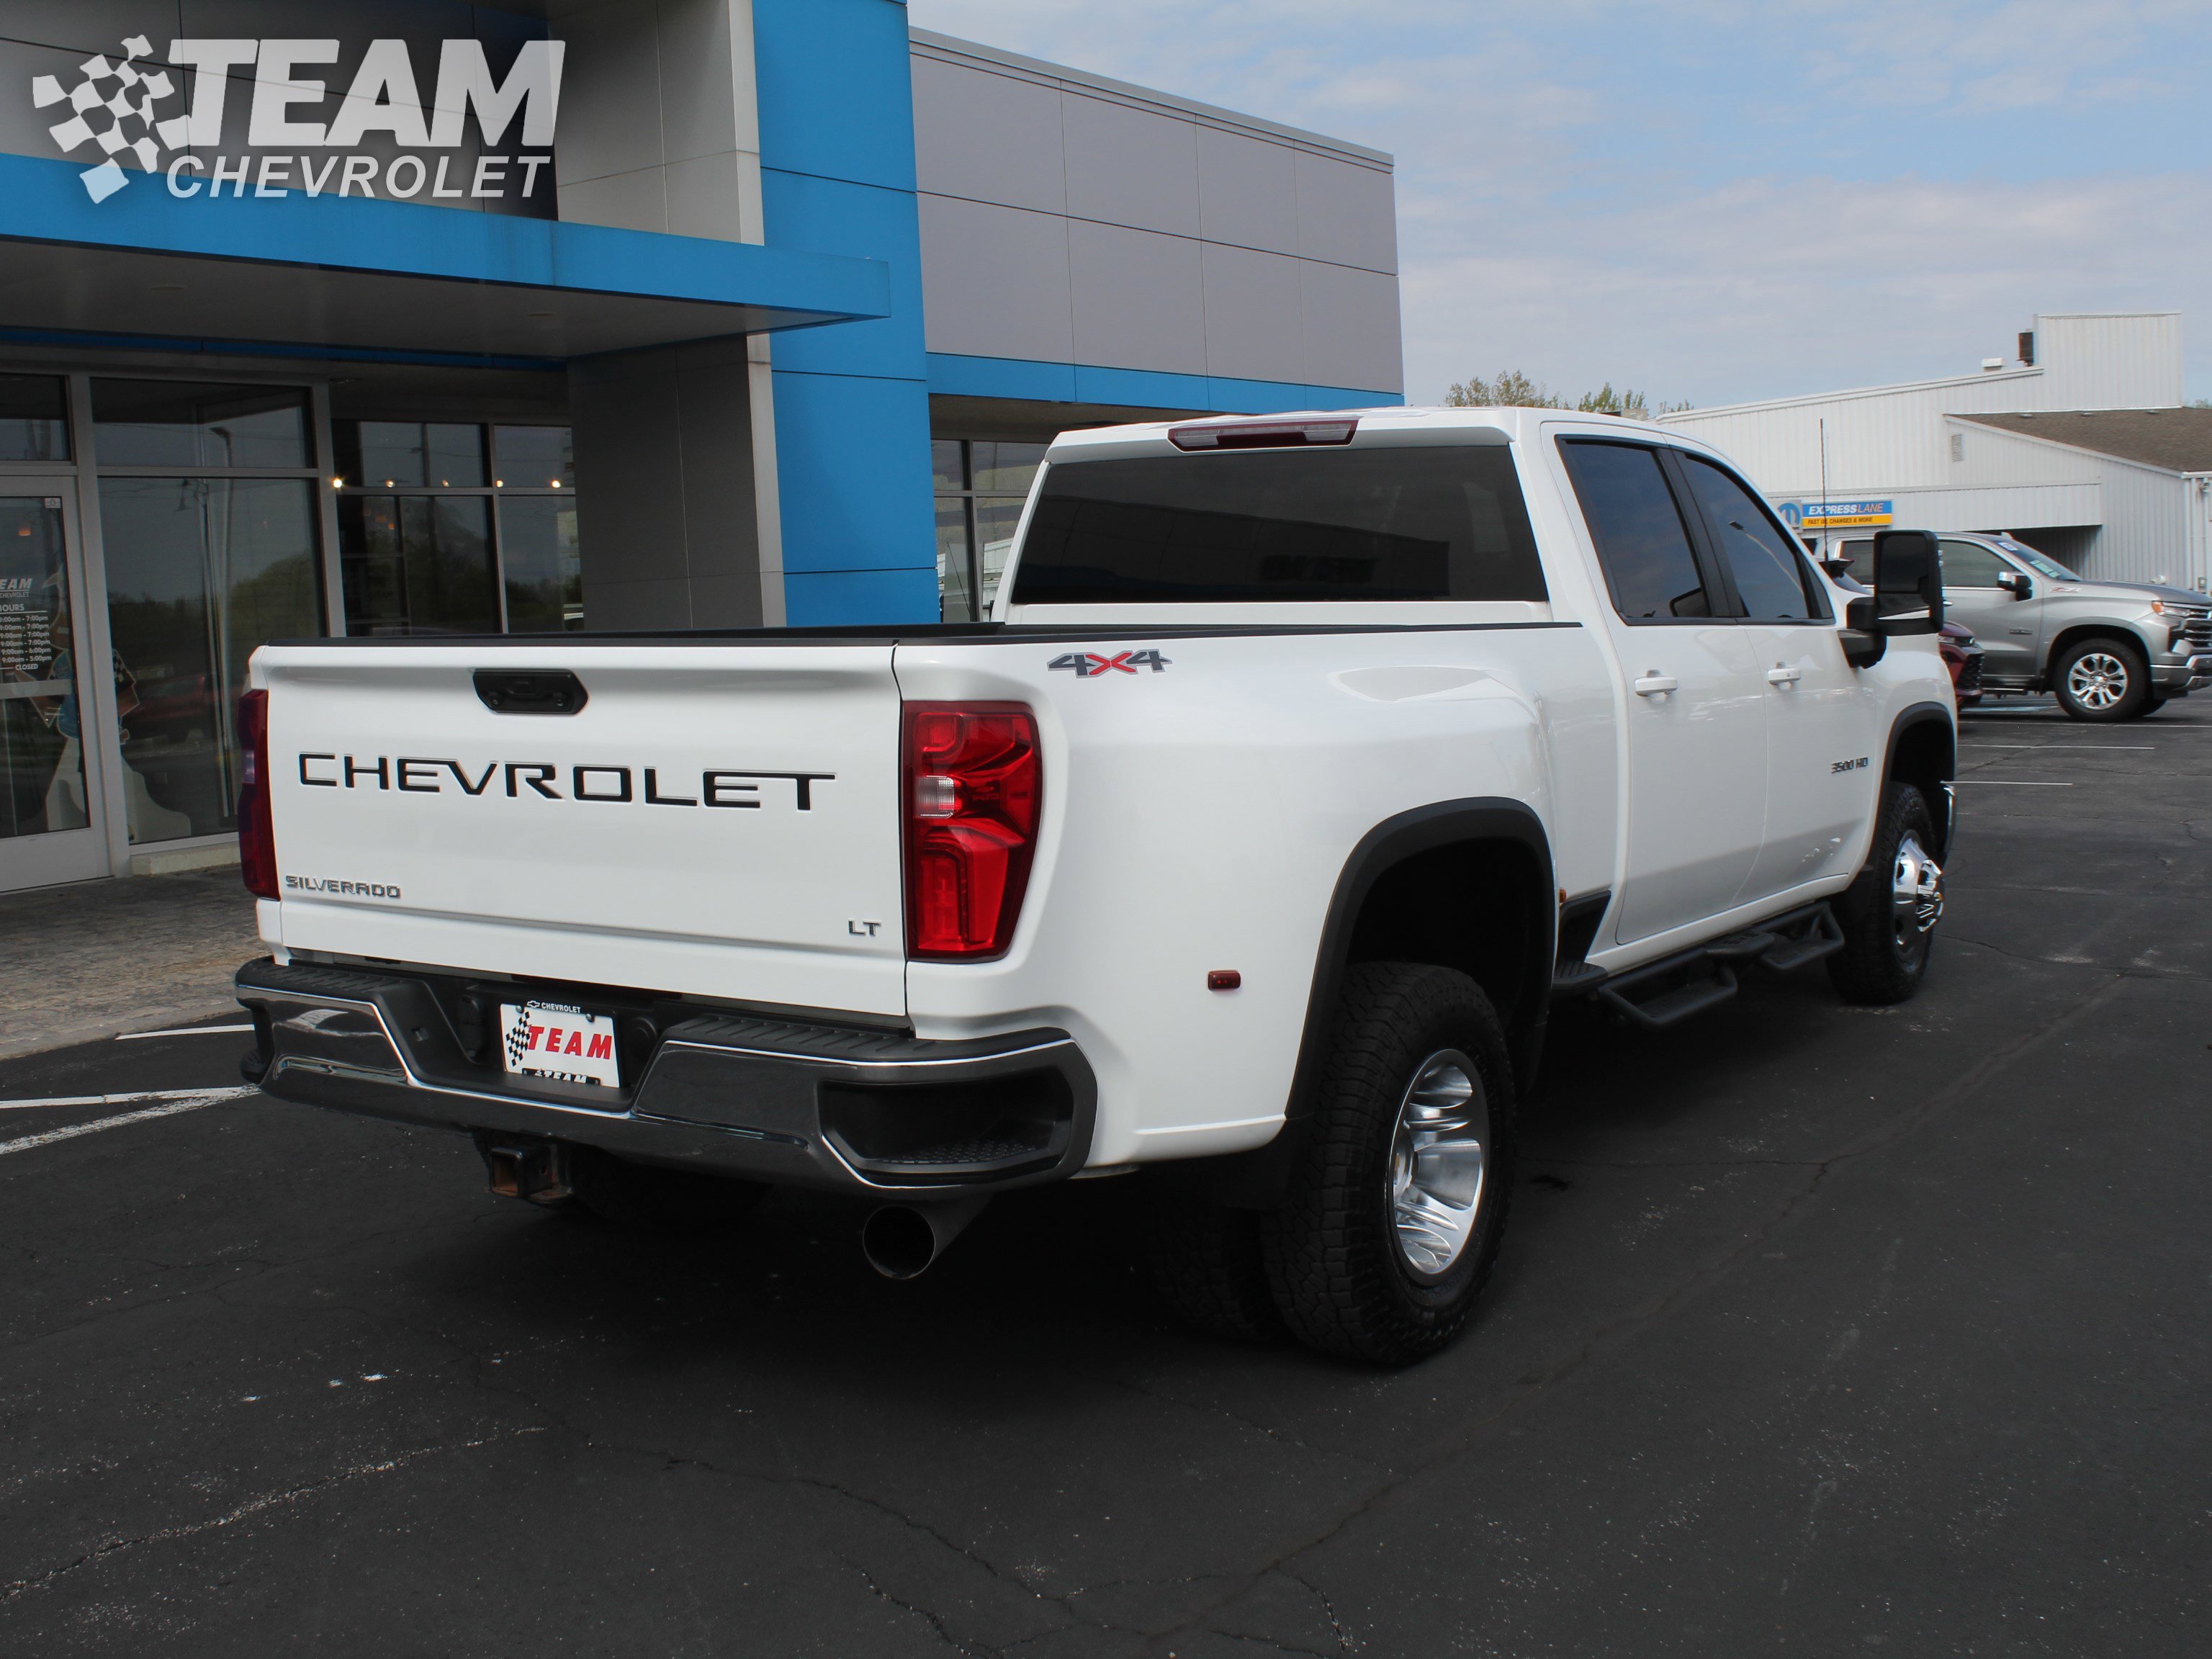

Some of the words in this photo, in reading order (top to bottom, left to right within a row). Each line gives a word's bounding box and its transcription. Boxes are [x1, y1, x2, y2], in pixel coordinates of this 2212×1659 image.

[1856, 757, 1868, 768] HD
[299, 752, 836, 811] CHEVROLET
[286, 876, 401, 898] SILVERADO
[848, 920, 882, 937] LT
[541, 1002, 581, 1014] CHEVROLET
[528, 1025, 612, 1059] TEAM
